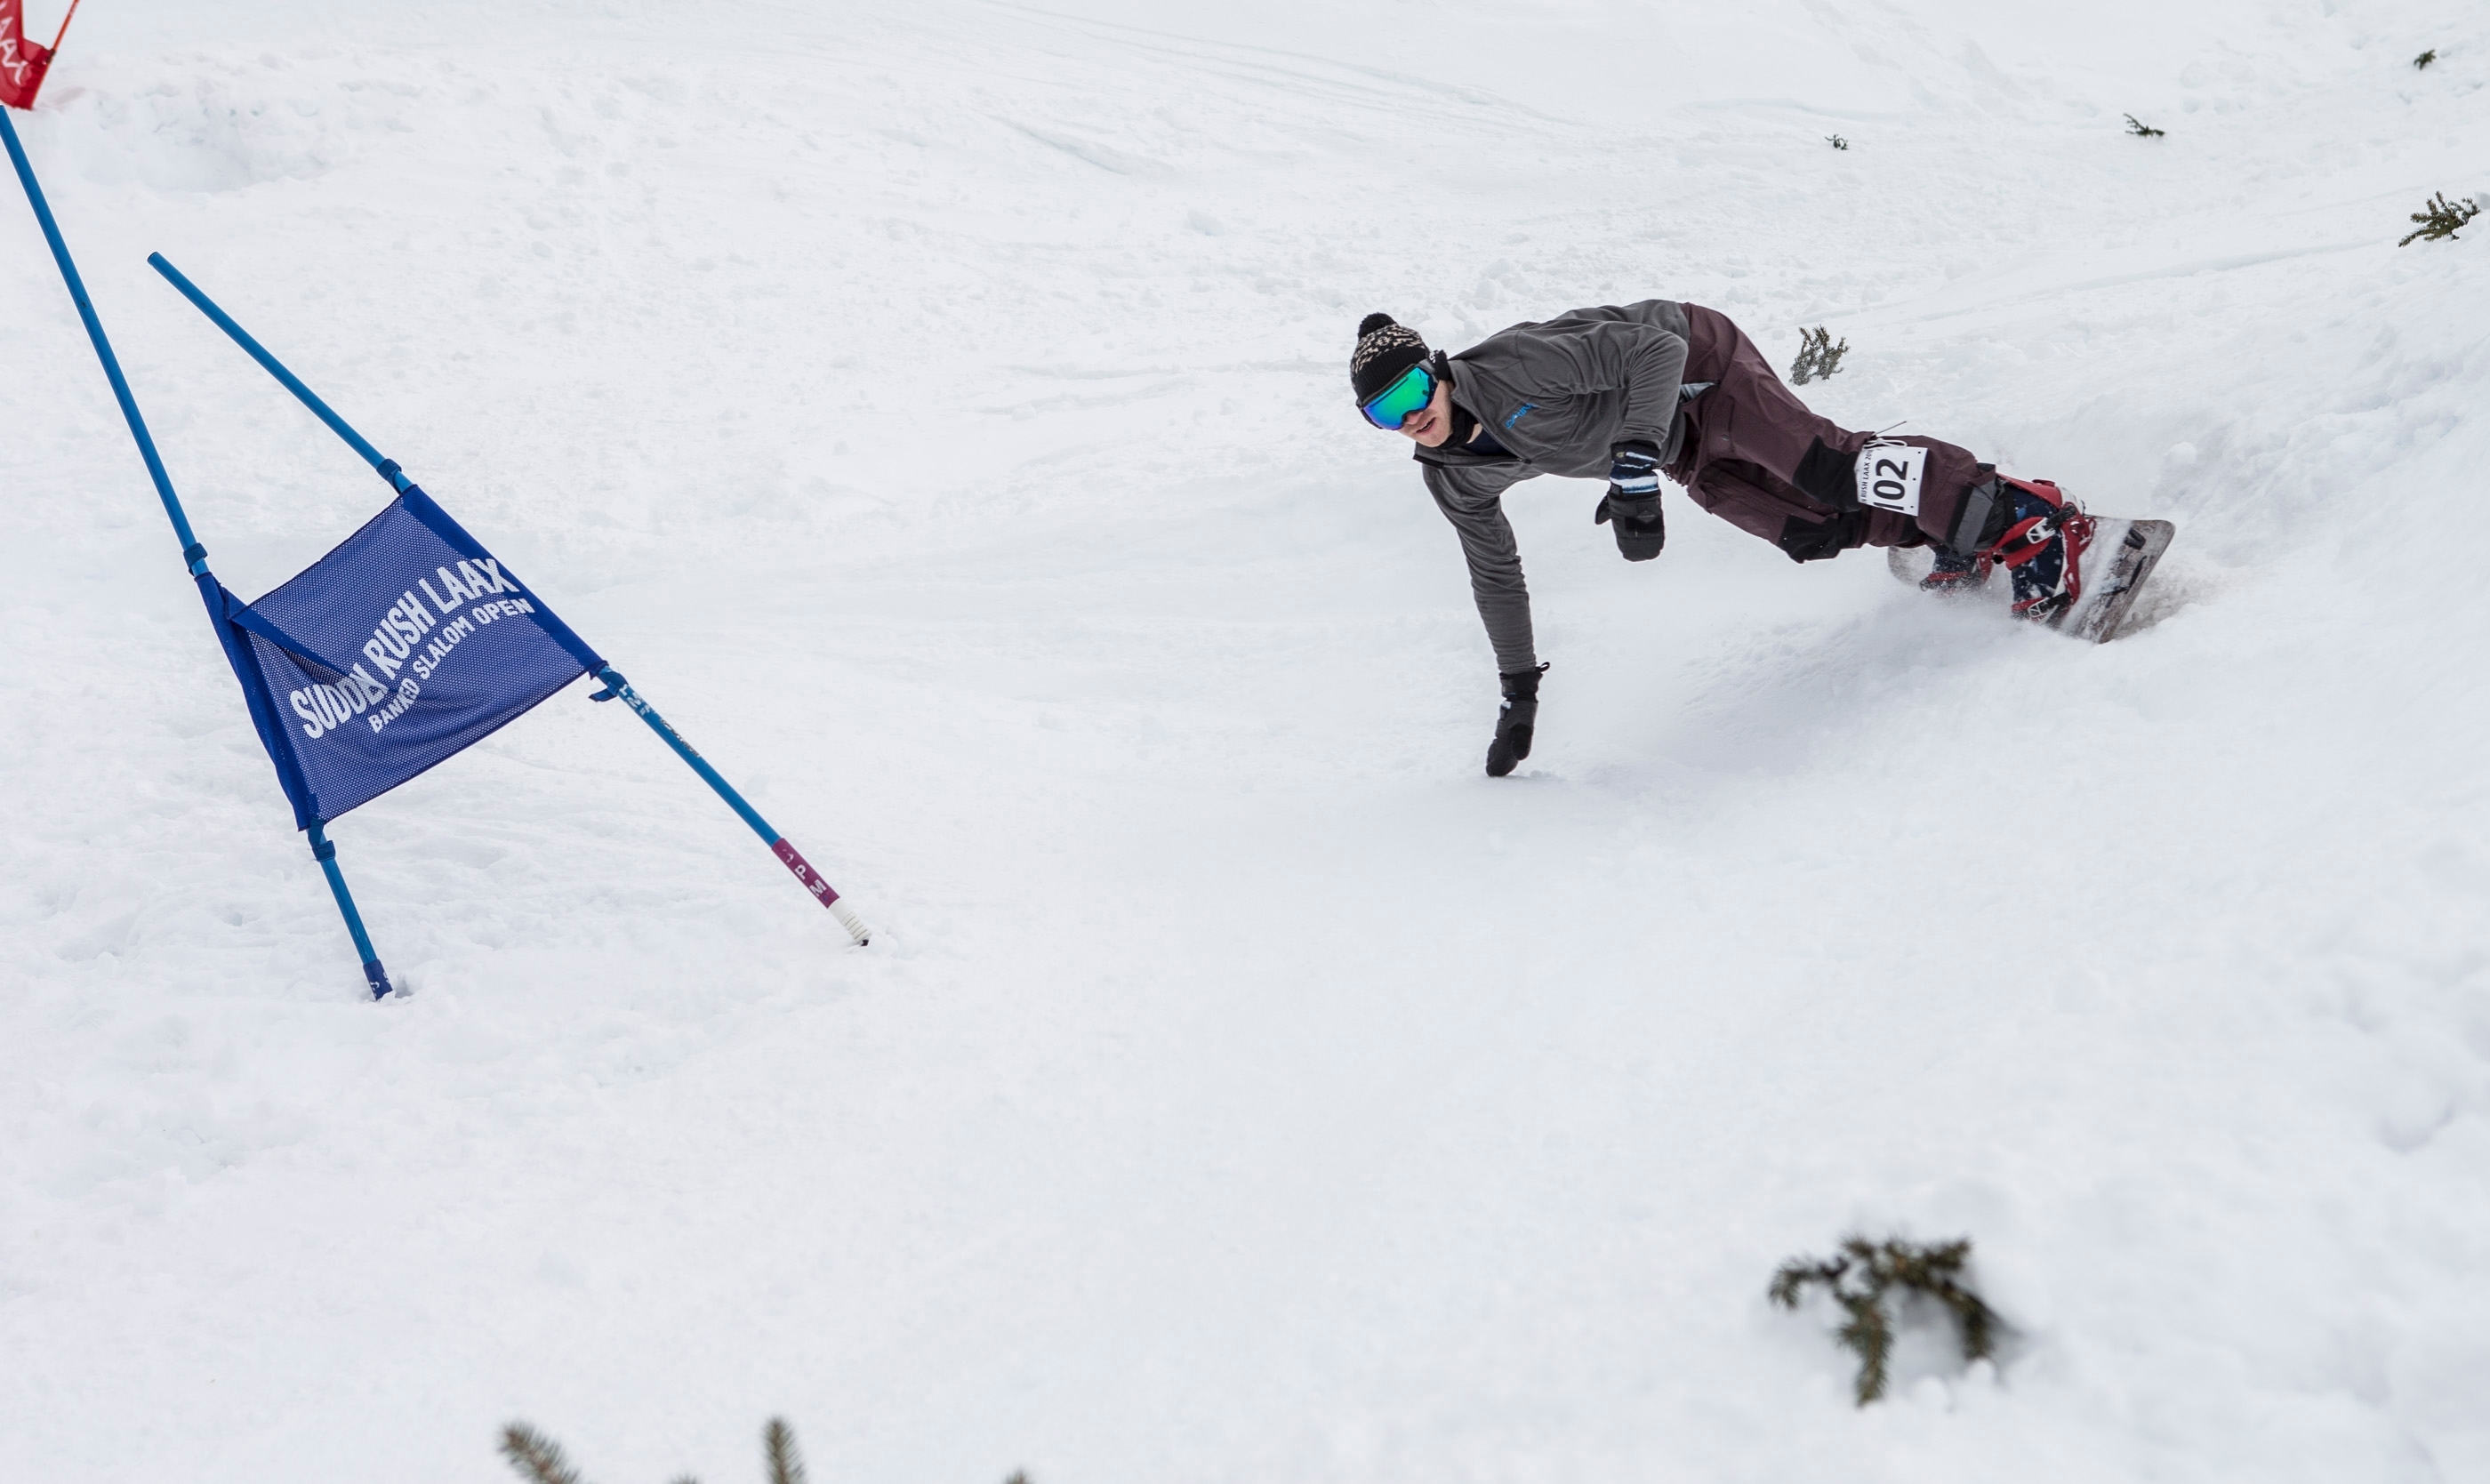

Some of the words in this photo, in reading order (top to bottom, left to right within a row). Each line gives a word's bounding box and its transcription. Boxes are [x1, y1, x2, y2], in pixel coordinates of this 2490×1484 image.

[1862, 462, 1870, 480] LAAX
[363, 590, 437, 680] RUSH
[419, 558, 519, 614] LAAX
[367, 678, 420, 734] BANKED
[413, 615, 476, 680] SLALOM
[472, 598, 535, 624] OPEN
